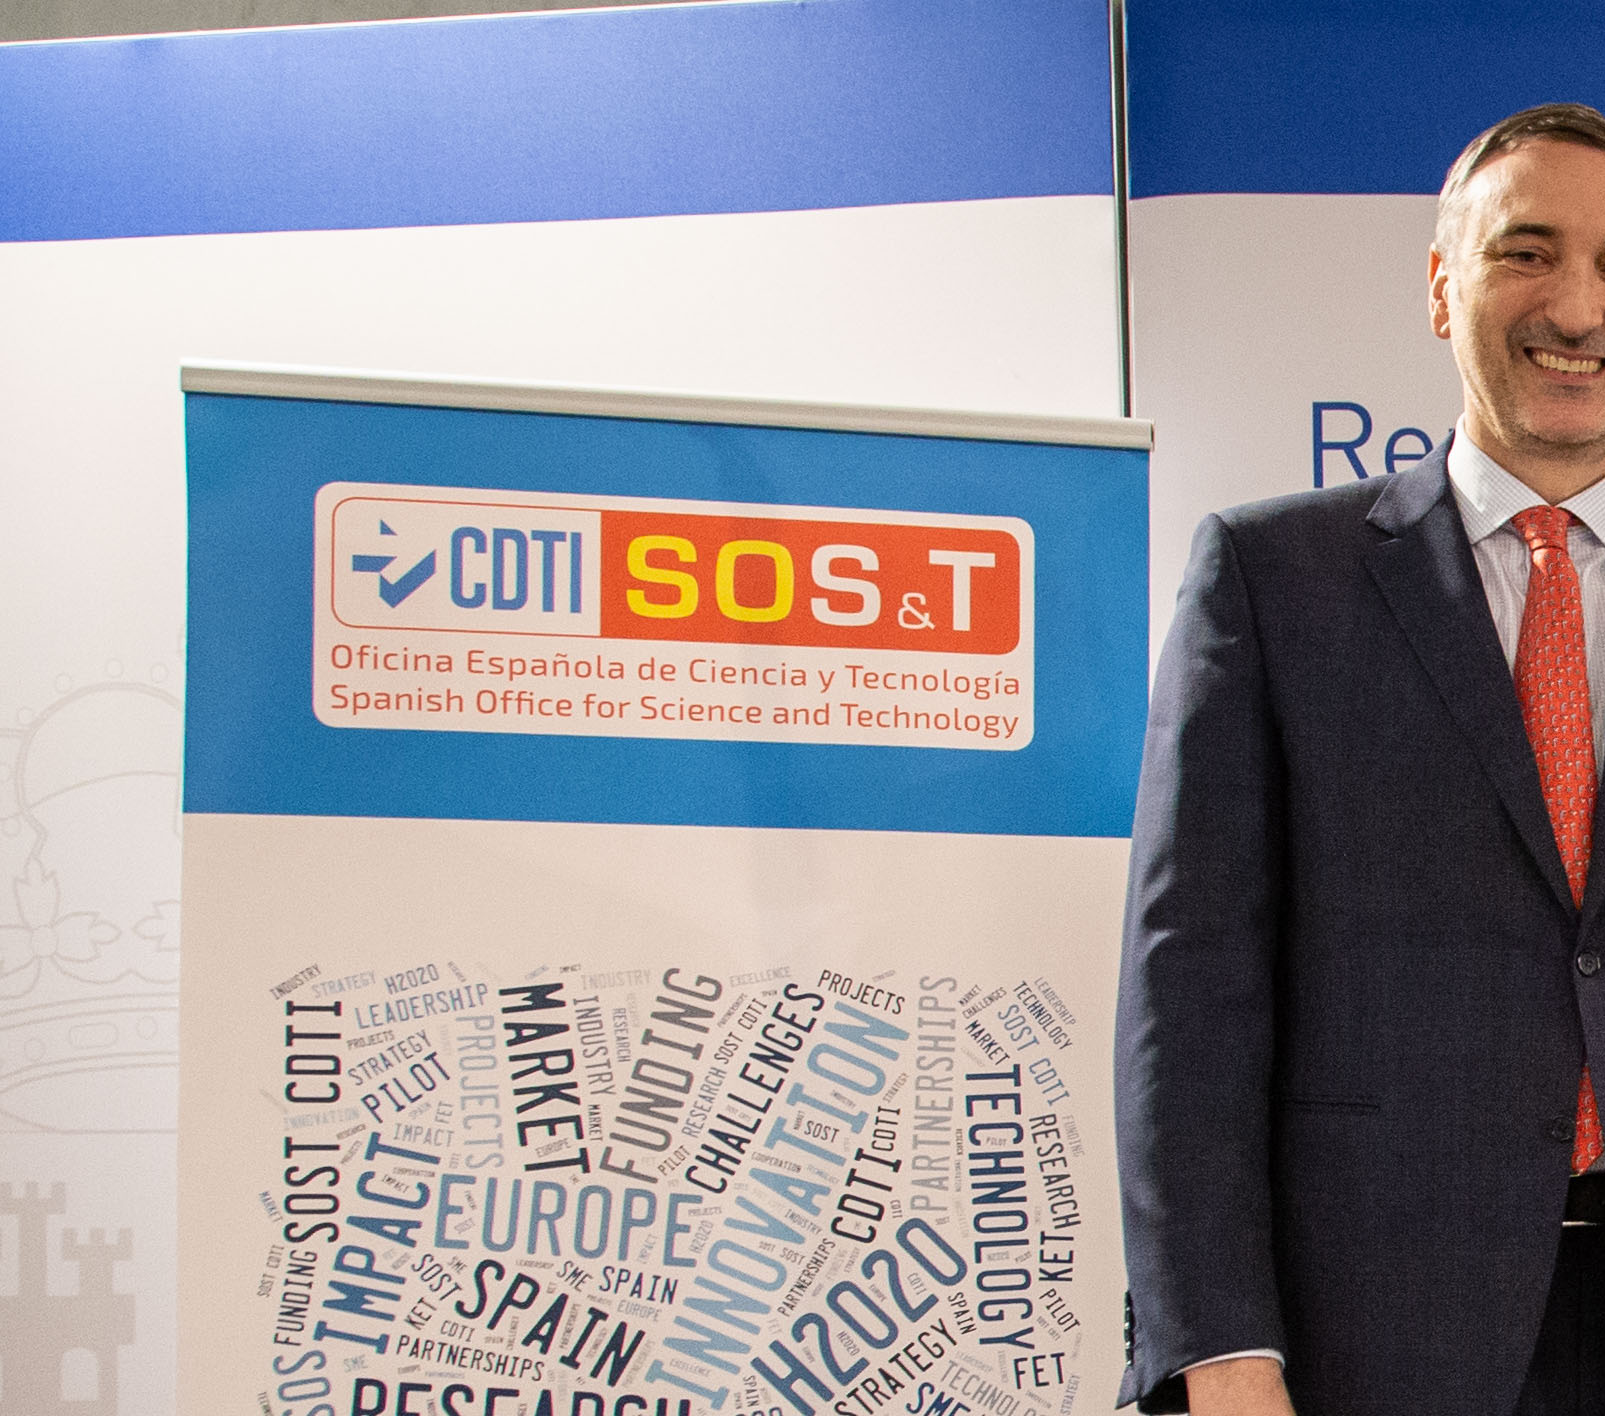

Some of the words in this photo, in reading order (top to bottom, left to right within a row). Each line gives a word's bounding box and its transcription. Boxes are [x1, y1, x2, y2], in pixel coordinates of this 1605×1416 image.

[449, 525, 584, 614] CDTI
[330, 684, 463, 715] Spanish
[476, 689, 573, 717] Office
[583, 693, 630, 718] for
[640, 695, 762, 724] Science
[773, 702, 830, 725] and
[840, 703, 1019, 738] Technology
[331, 644, 453, 673] Oficina
[467, 649, 624, 681] Española
[638, 658, 676, 681] de
[689, 659, 806, 686] Ciencia
[819, 671, 834, 693] y
[846, 665, 1019, 700] Tecnología
[355, 983, 489, 1030] LEADERSHIP
[384, 963, 440, 996] H2020
[818, 969, 907, 1015] PROJECTS
[284, 1000, 342, 1103] CDTI
[347, 1029, 433, 1087] STRATEGY
[360, 1051, 451, 1124] PILOT
[456, 1015, 506, 1169] PROJECTS
[498, 982, 591, 1173] MARKET
[573, 995, 618, 1097] INDUSTRY
[599, 967, 723, 1184] FUNDING
[685, 983, 825, 1194] CHALLENGES
[911, 975, 959, 1213] PARTNERSHIPS
[283, 1136, 341, 1244] SOST
[434, 1173, 703, 1269] EUROPE
[645, 1000, 910, 1411] INNOVATION
[830, 1147, 902, 1244] CDTI
[965, 1063, 1036, 1350] TECHNOLOGY
[1029, 1113, 1082, 1230] RESEARCH
[313, 1131, 441, 1355] IMPACT
[1038, 1230, 1075, 1283] KET
[396, 1334, 546, 1382] PARTNERSHIPS
[455, 1259, 646, 1387] SPAIN
[1013, 1352, 1066, 1389] FET
